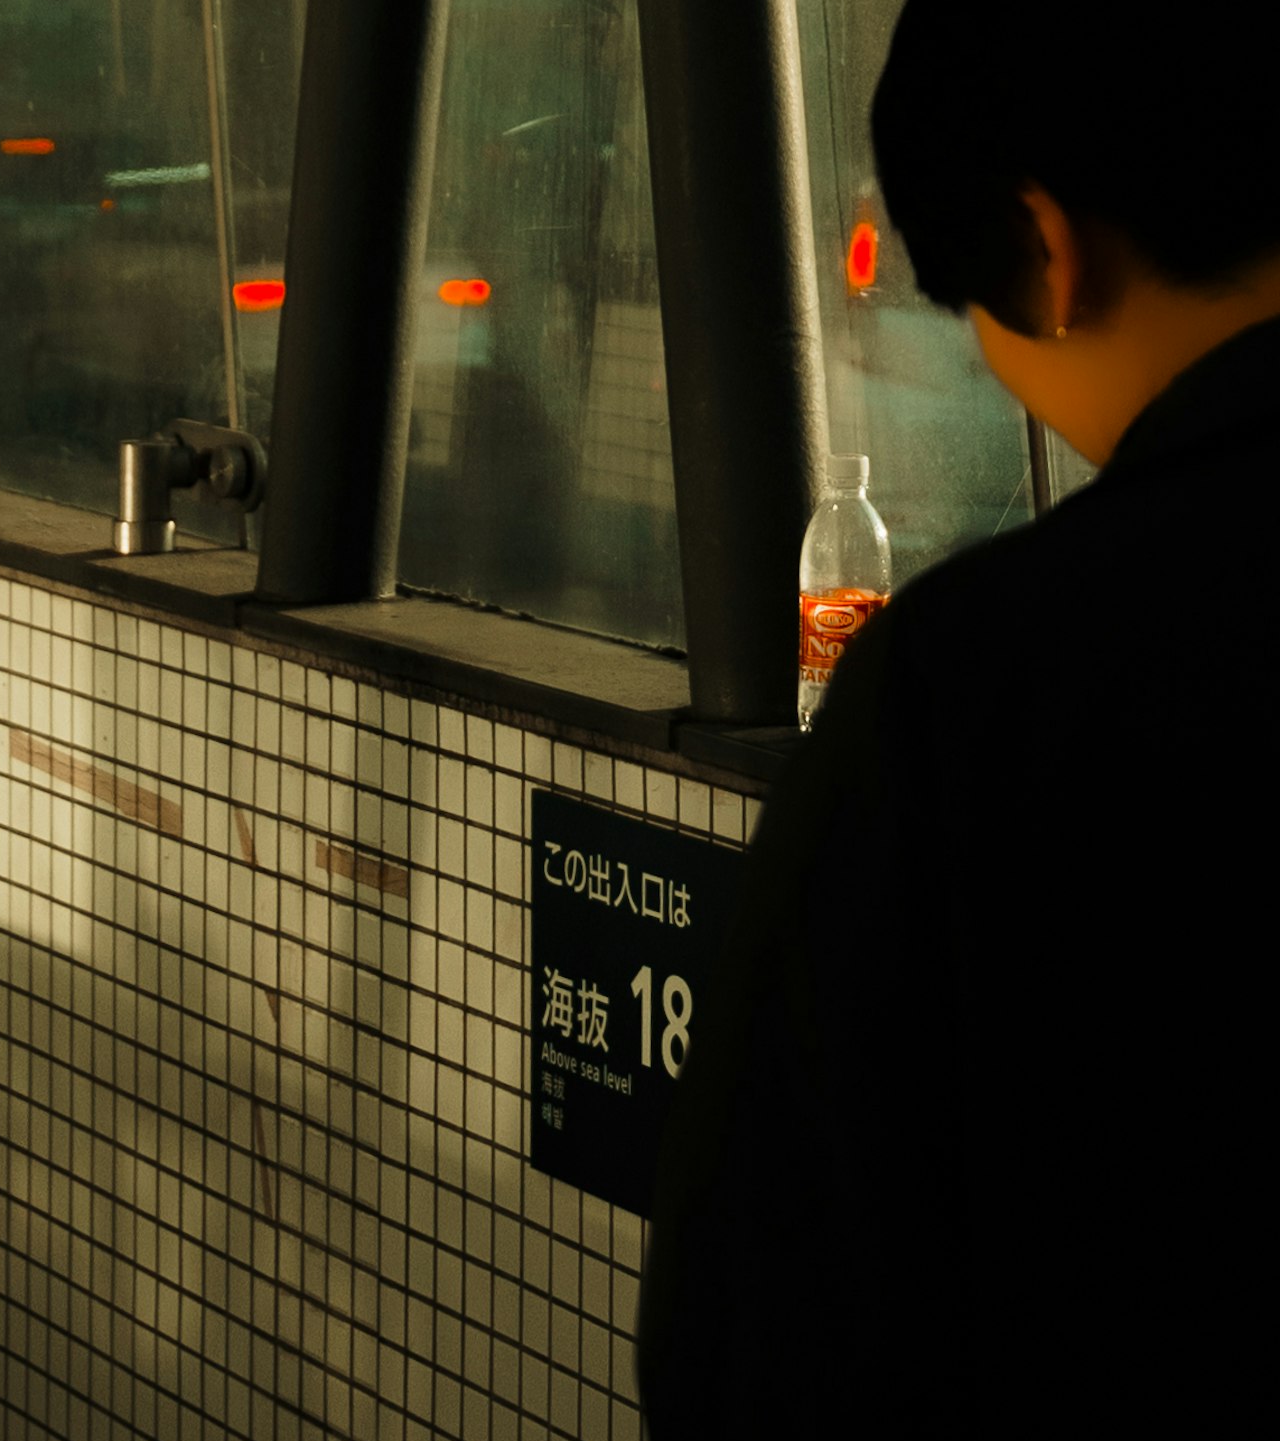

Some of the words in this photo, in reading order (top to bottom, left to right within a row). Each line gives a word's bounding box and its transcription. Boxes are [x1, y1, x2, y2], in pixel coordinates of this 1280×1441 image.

[800, 666, 831, 684] TAN
[543, 840, 691, 929] この出入口は
[542, 965, 610, 1053] 海抜
[630, 965, 693, 1081] 18
[541, 1041, 578, 1073] Above
[580, 1061, 601, 1084] sea
[603, 1063, 632, 1097] level
